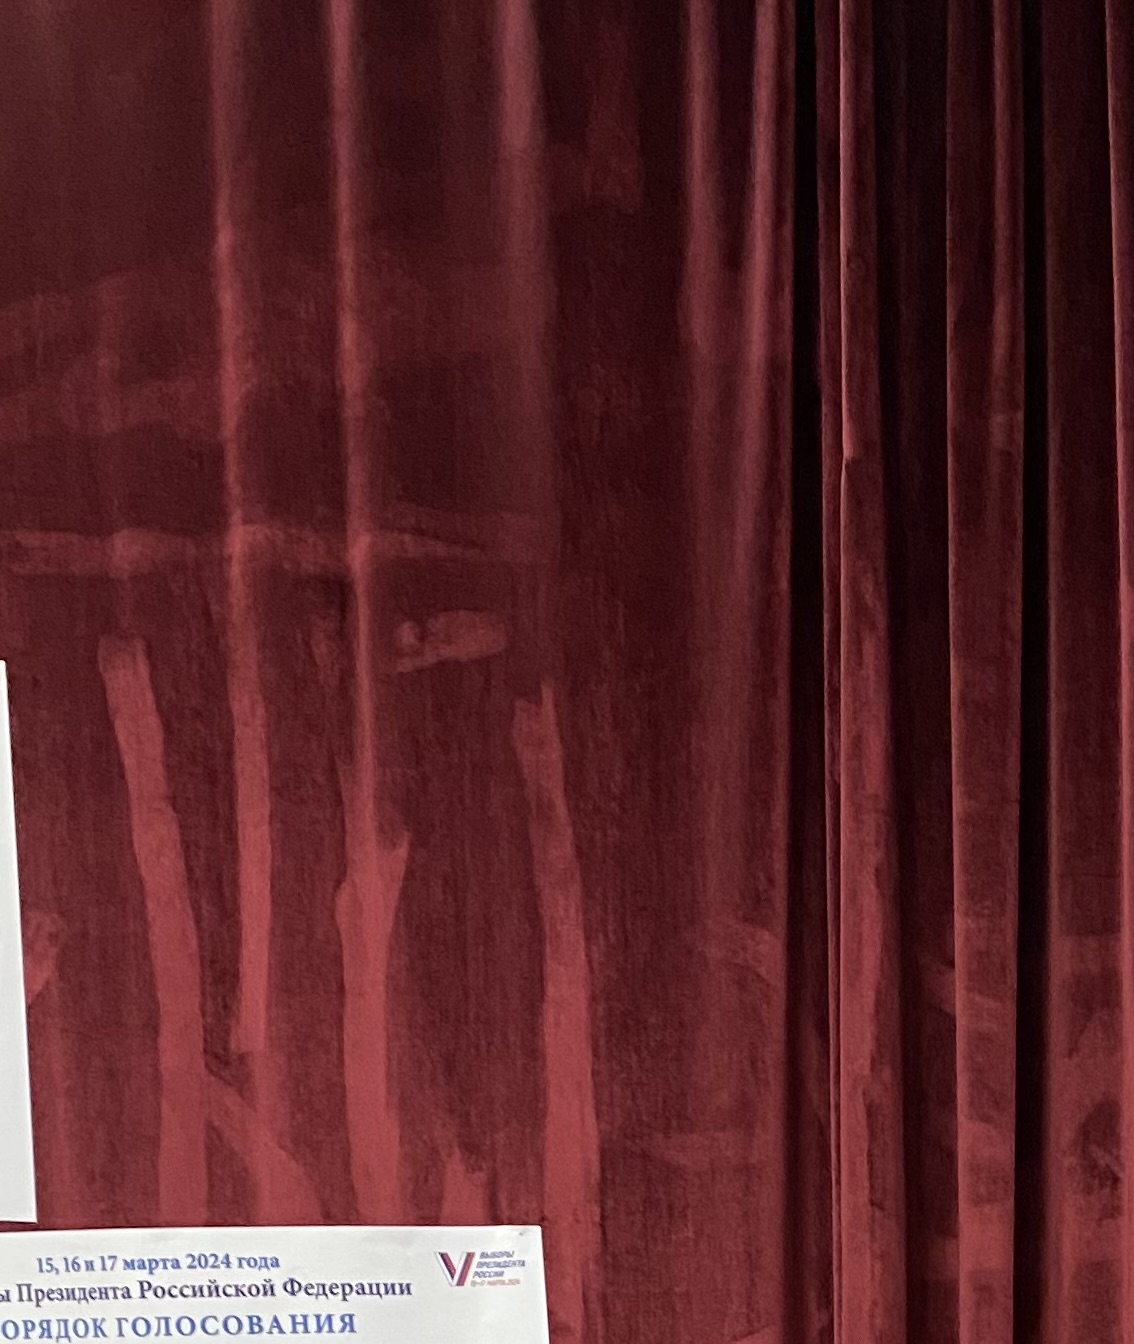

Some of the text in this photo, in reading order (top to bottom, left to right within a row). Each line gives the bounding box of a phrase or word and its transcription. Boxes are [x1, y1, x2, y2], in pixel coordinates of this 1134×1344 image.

[37, 1253, 281, 1275] 15, 16 и 17 марта 2024 года
[16, 1283, 133, 1308] Президента
[137, 1278, 276, 1300] Российской
[282, 1277, 412, 1302] Федерации
[115, 1313, 358, 1338] ГОЛОСОВАНИЯ
